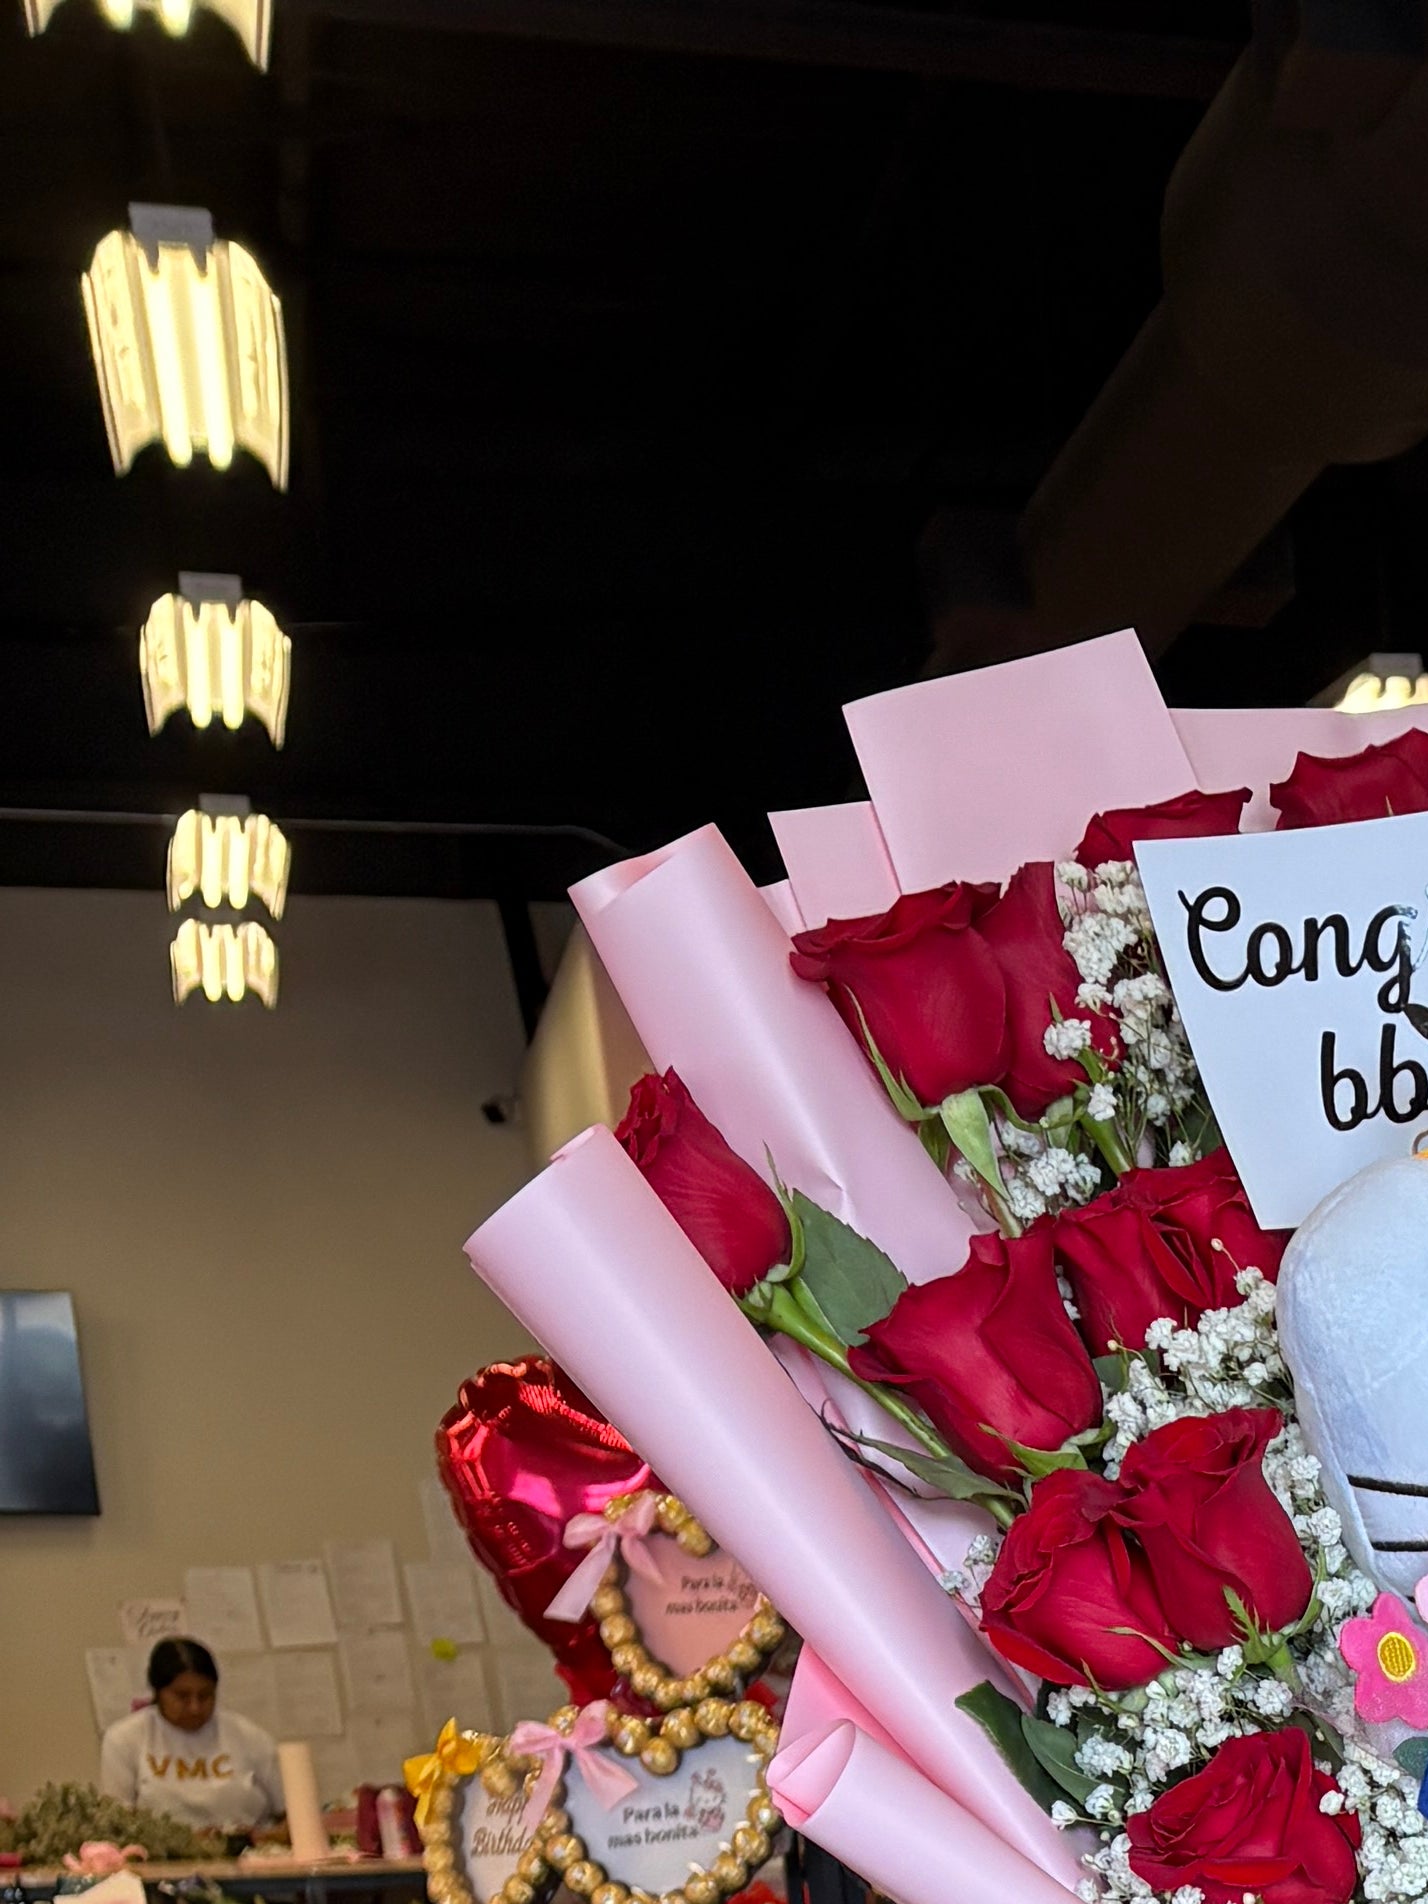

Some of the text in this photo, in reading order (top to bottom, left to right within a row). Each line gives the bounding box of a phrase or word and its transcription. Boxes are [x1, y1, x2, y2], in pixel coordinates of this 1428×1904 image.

[146, 1753, 234, 1780] VMC
[623, 1801, 680, 1824] Para la
[644, 1824, 699, 1845] bonita
